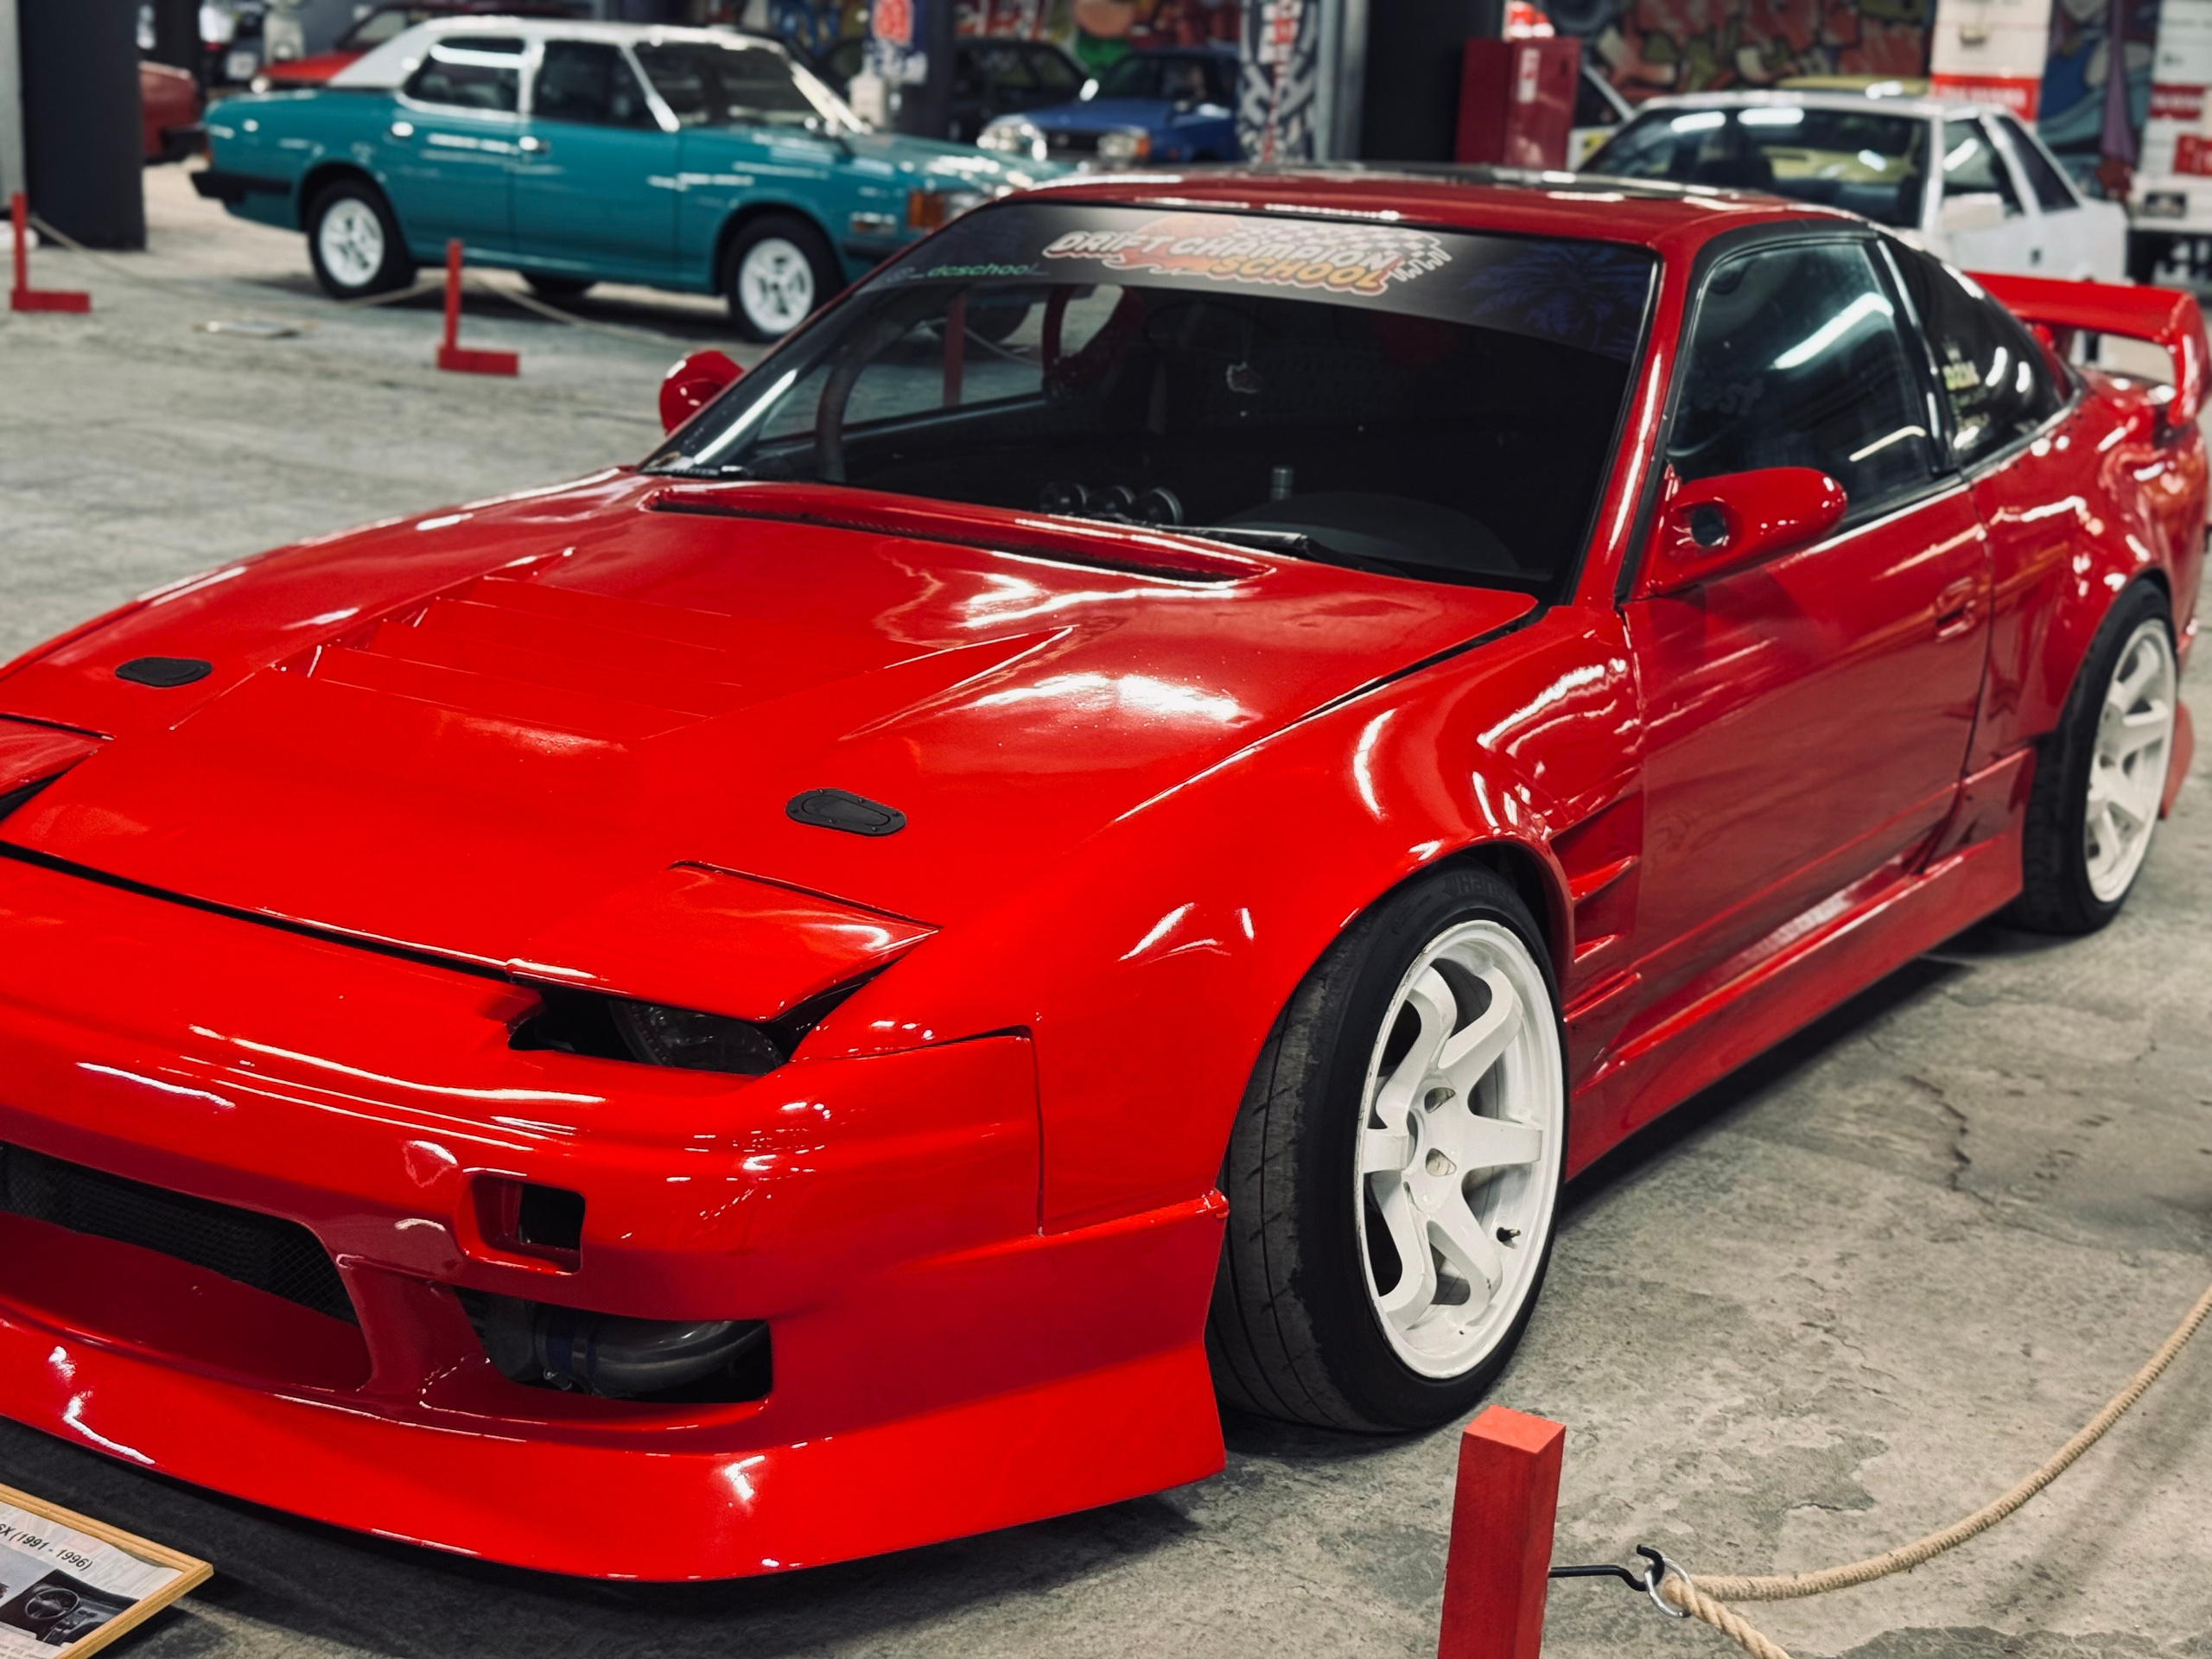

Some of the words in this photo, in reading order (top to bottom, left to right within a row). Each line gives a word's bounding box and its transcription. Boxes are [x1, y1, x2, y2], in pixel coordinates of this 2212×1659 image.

[1047, 231, 1176, 253] DRIFT
[1169, 235, 1403, 270] CHAMPION
[1211, 256, 1384, 289] SCHOOL
[8, 1530, 50, 1551] (1991
[55, 1548, 93, 1572] 1996)
